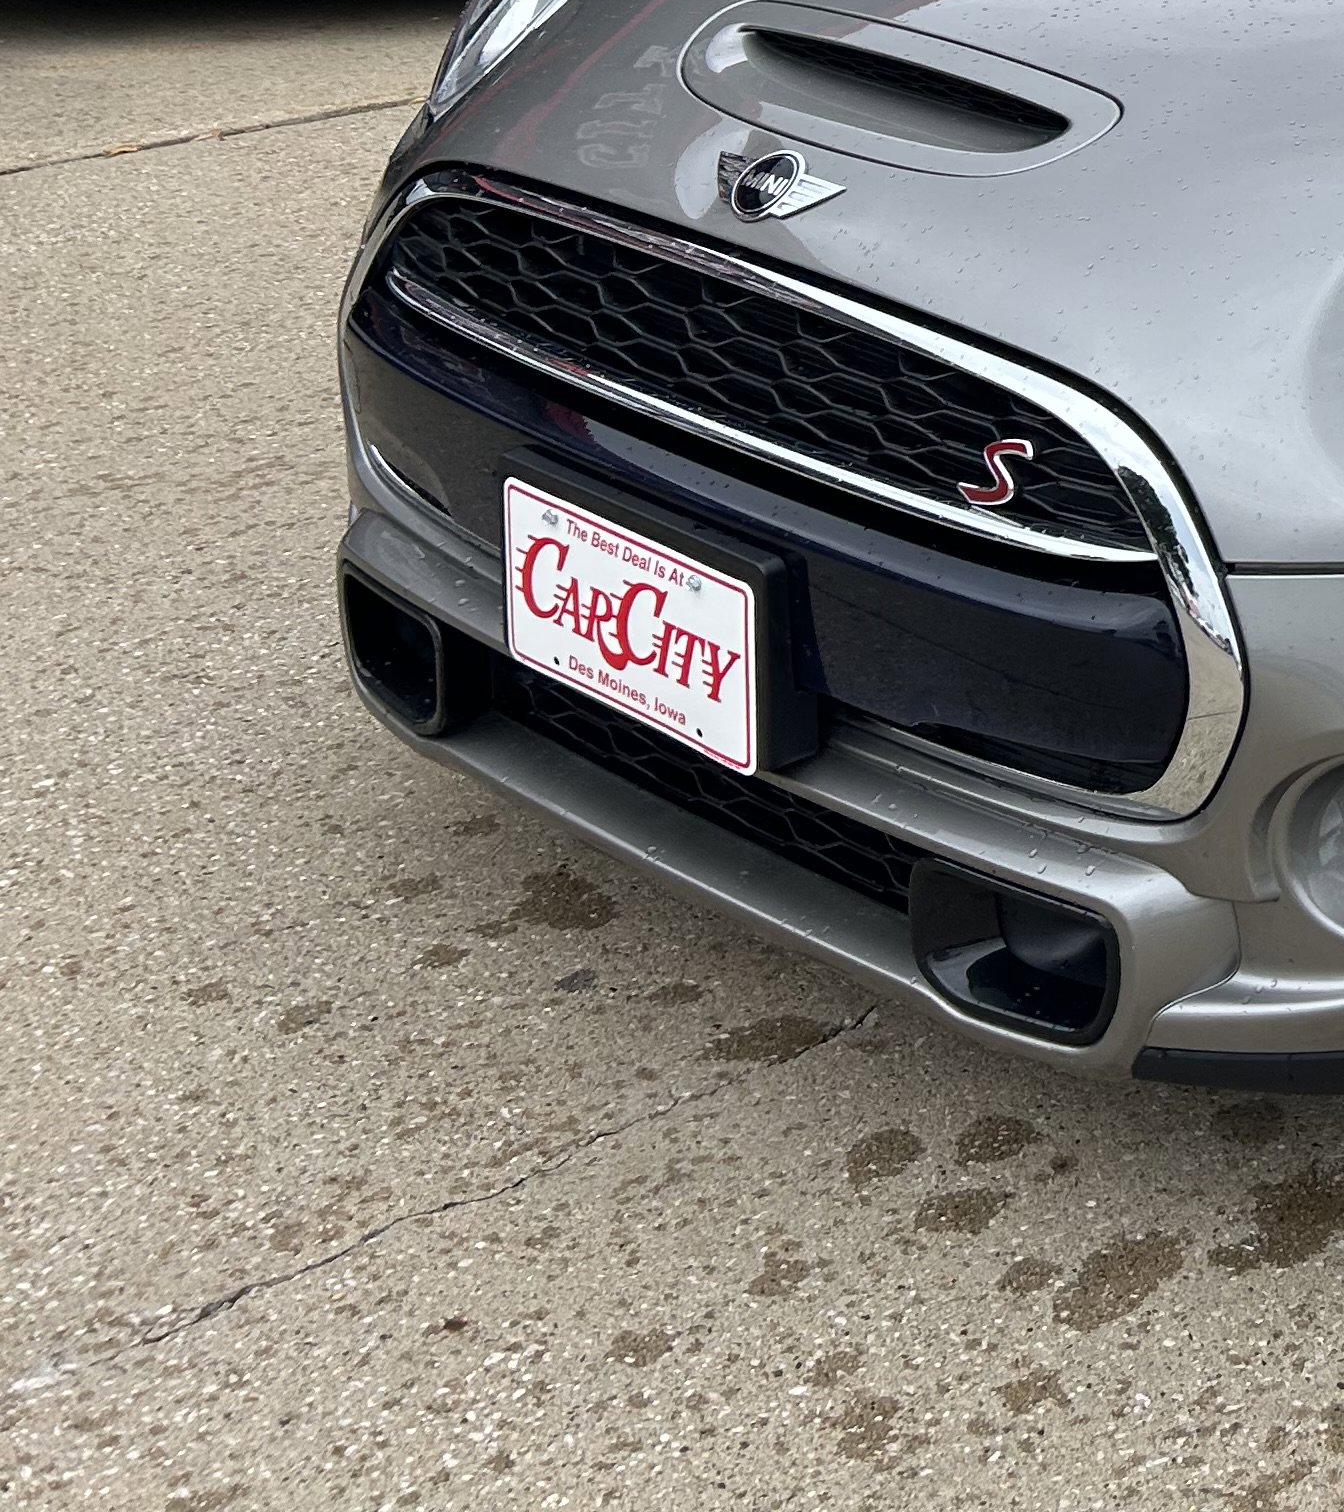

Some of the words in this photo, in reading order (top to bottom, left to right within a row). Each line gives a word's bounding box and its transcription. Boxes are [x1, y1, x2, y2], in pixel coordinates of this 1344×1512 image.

[741, 169, 789, 196] MINI
[957, 438, 1034, 506] S
[566, 518, 588, 543] The
[591, 531, 620, 558] Best
[622, 546, 652, 572] Deal
[653, 560, 666, 579] Is
[668, 568, 685, 587] At
[568, 654, 594, 680] Des
[597, 669, 650, 711] Moines,
[654, 696, 686, 726] Iowa
